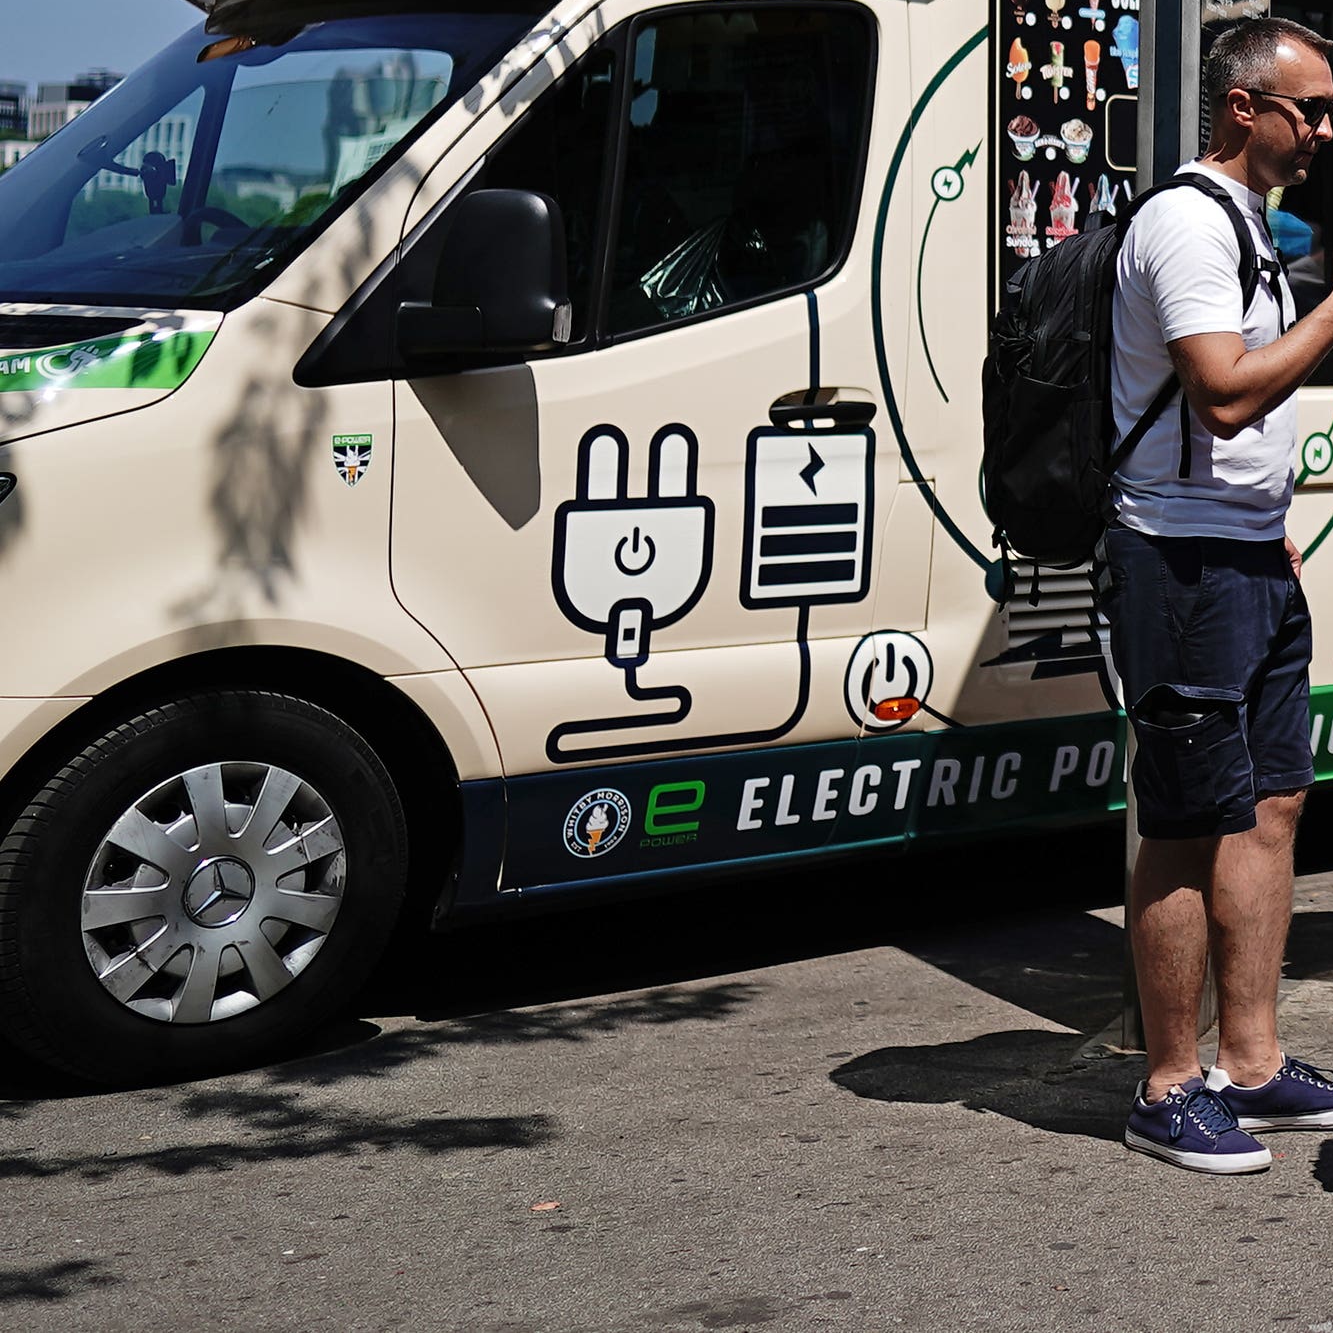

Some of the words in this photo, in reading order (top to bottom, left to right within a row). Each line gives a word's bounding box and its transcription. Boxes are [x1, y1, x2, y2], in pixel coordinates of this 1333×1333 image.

[645, 780, 706, 836] e
[735, 751, 1022, 832] ELECTRIC
[1048, 739, 1128, 793] PO
[566, 796, 592, 839] WHITBY
[596, 791, 629, 833] MORRISON
[639, 833, 697, 849] POWER
